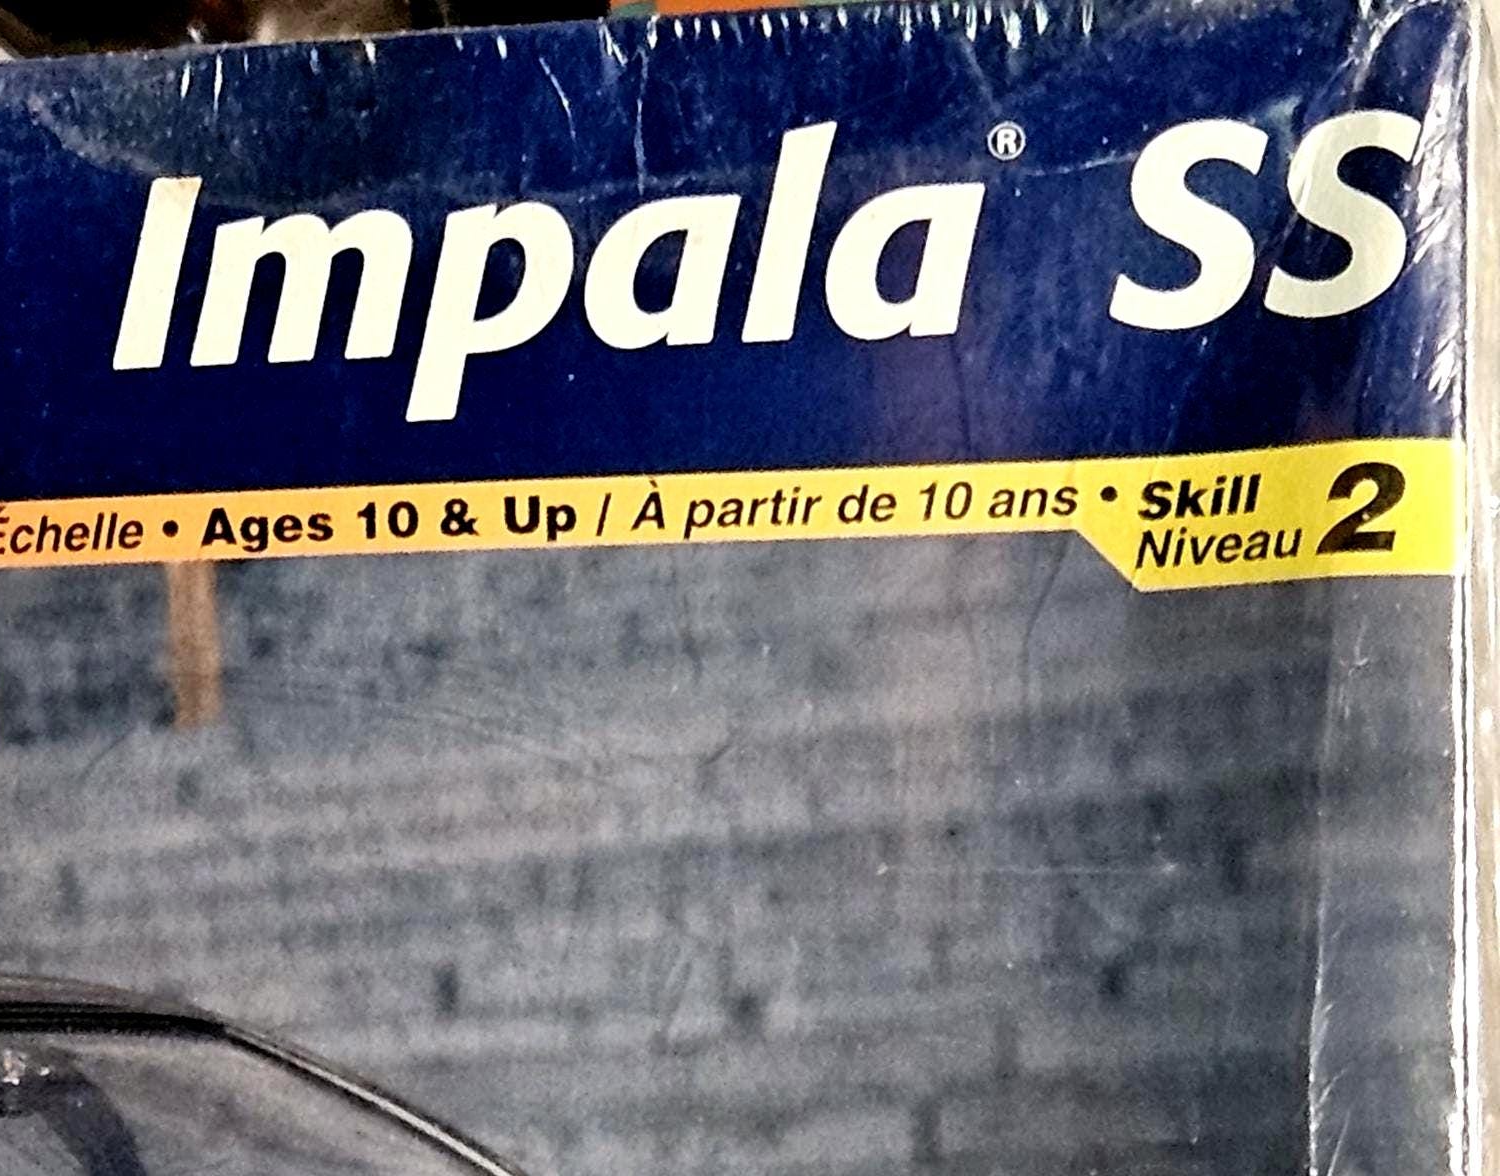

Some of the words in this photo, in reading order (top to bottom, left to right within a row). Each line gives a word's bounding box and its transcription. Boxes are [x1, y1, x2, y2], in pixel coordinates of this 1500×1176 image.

[111, 120, 986, 423] Impala
[1108, 108, 1422, 333] SS
[201, 506, 334, 553] Ages
[357, 501, 419, 539] 10
[440, 499, 480, 537] &
[503, 494, 577, 541] Up
[631, 480, 666, 531] À
[683, 485, 820, 542] partir
[837, 483, 897, 524] de
[918, 481, 972, 521] 10
[988, 480, 1080, 519] ans
[1135, 527, 1302, 569] Niveau
[1138, 473, 1263, 521] Skill
[1316, 461, 1407, 555] 2
